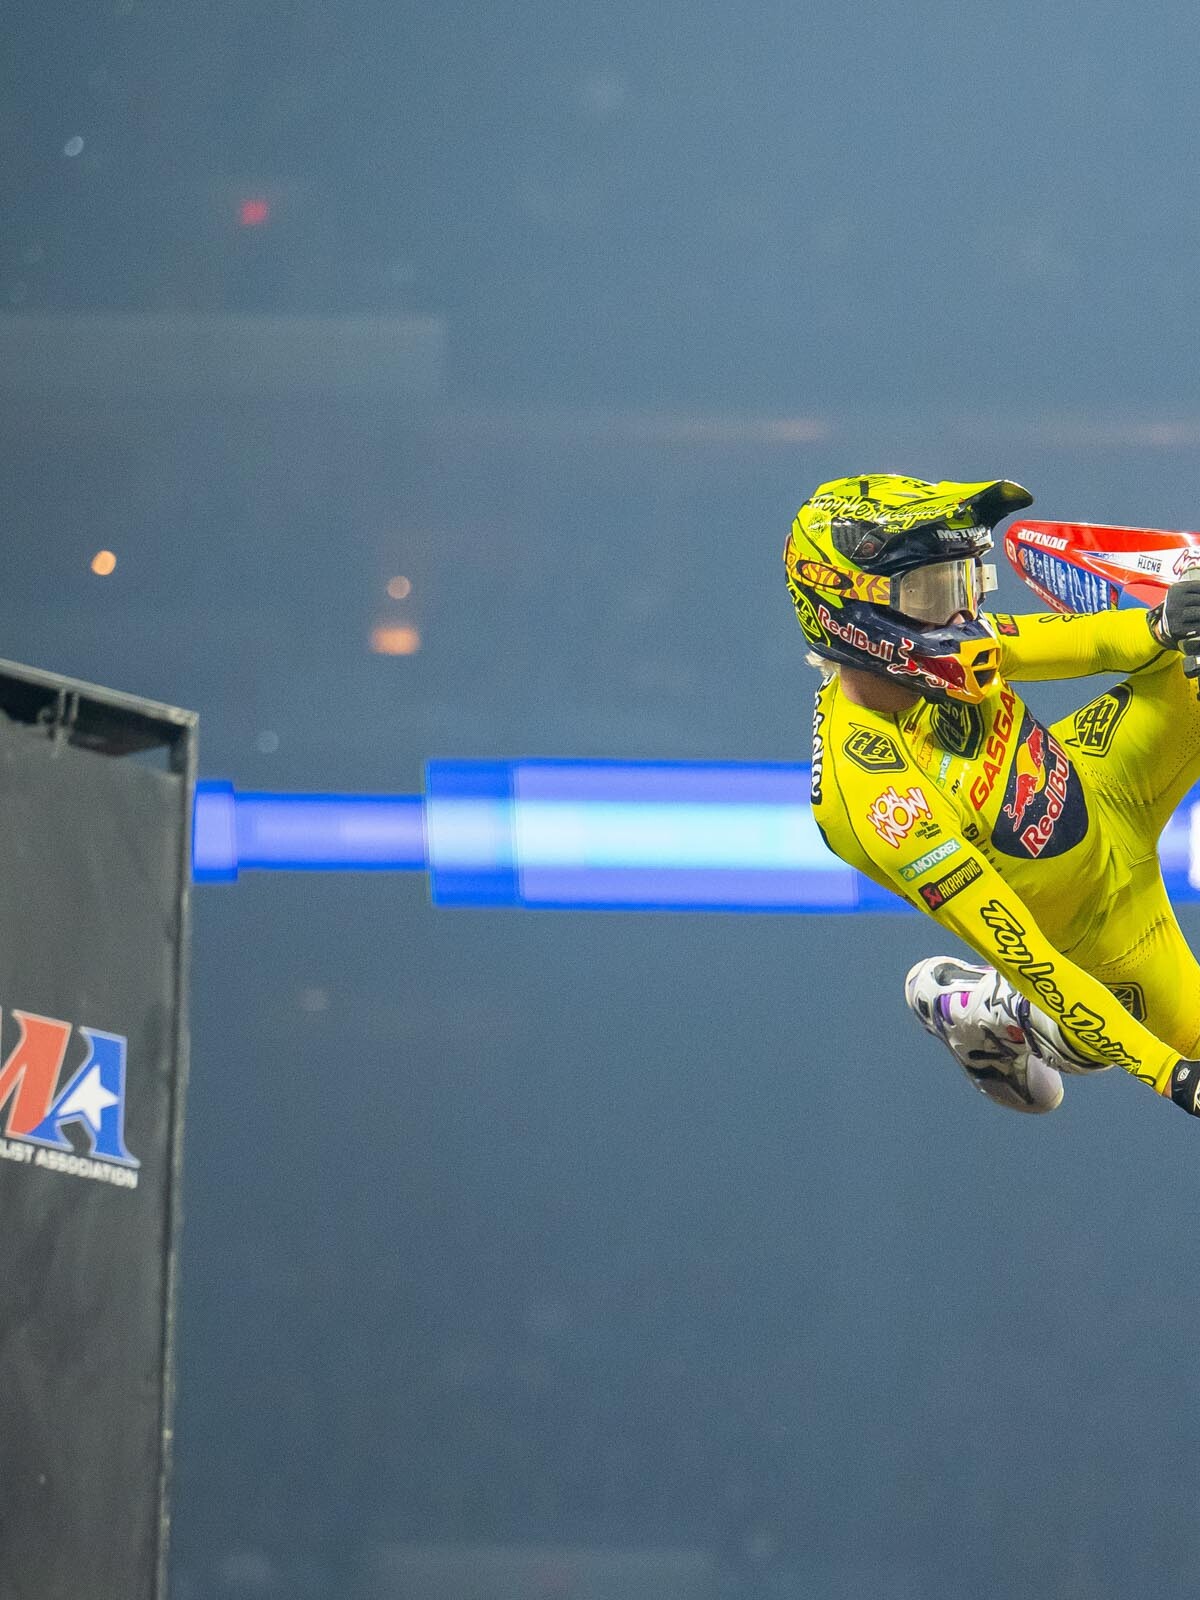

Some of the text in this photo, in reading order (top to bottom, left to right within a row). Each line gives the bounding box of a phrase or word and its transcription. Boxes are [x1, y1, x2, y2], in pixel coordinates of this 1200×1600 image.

[1017, 529, 1068, 551] DUNLOP
[913, 840, 960, 873] MOTOREX
[980, 899, 1033, 965] Troy
[1018, 961, 1066, 1014] Lee
